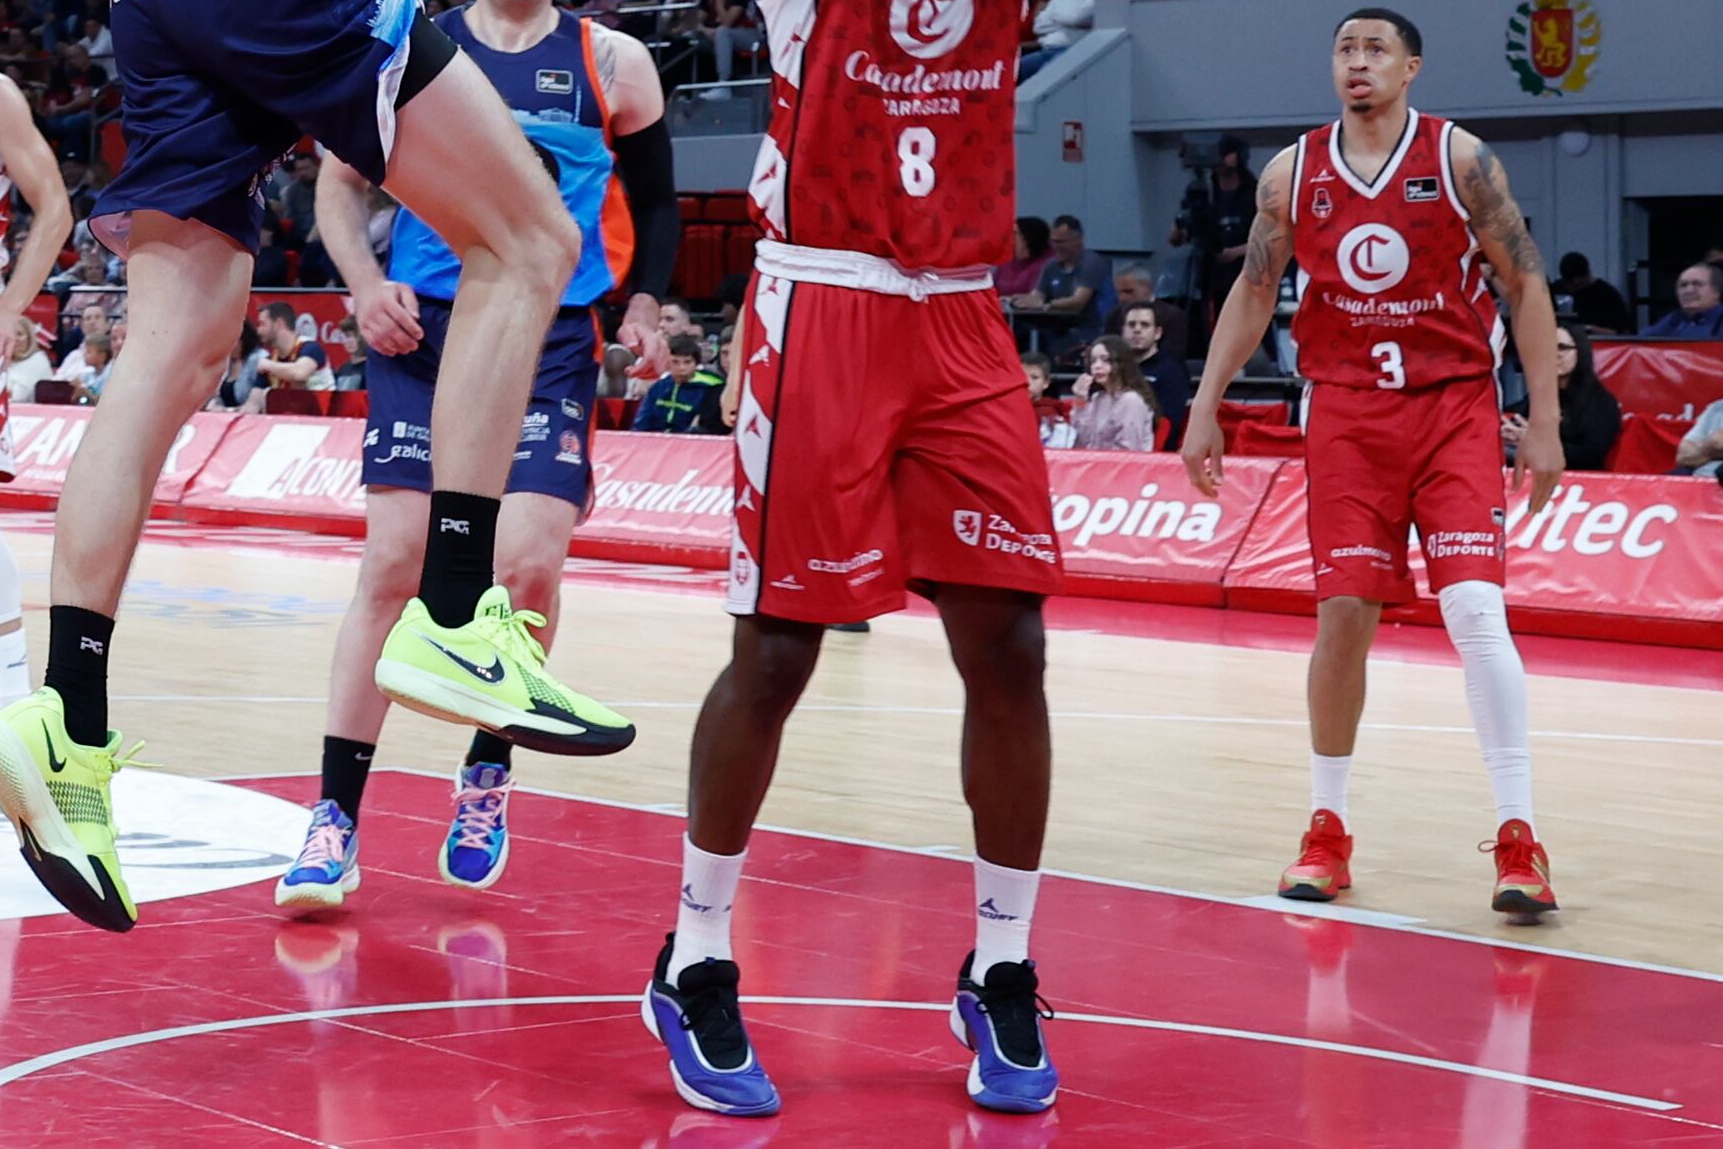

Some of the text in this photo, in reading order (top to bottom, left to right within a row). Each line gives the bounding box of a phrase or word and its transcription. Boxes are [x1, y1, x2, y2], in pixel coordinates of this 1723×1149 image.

[845, 50, 1006, 93] Caademont
[898, 126, 937, 198] 8
[1371, 341, 1406, 390] 3
[523, 411, 550, 425] uña
[1051, 483, 1222, 547] opina
[1436, 531, 1494, 545] Zaragoza
[1506, 485, 1679, 558] itec
[1436, 544, 1495, 559] DEPORTE
